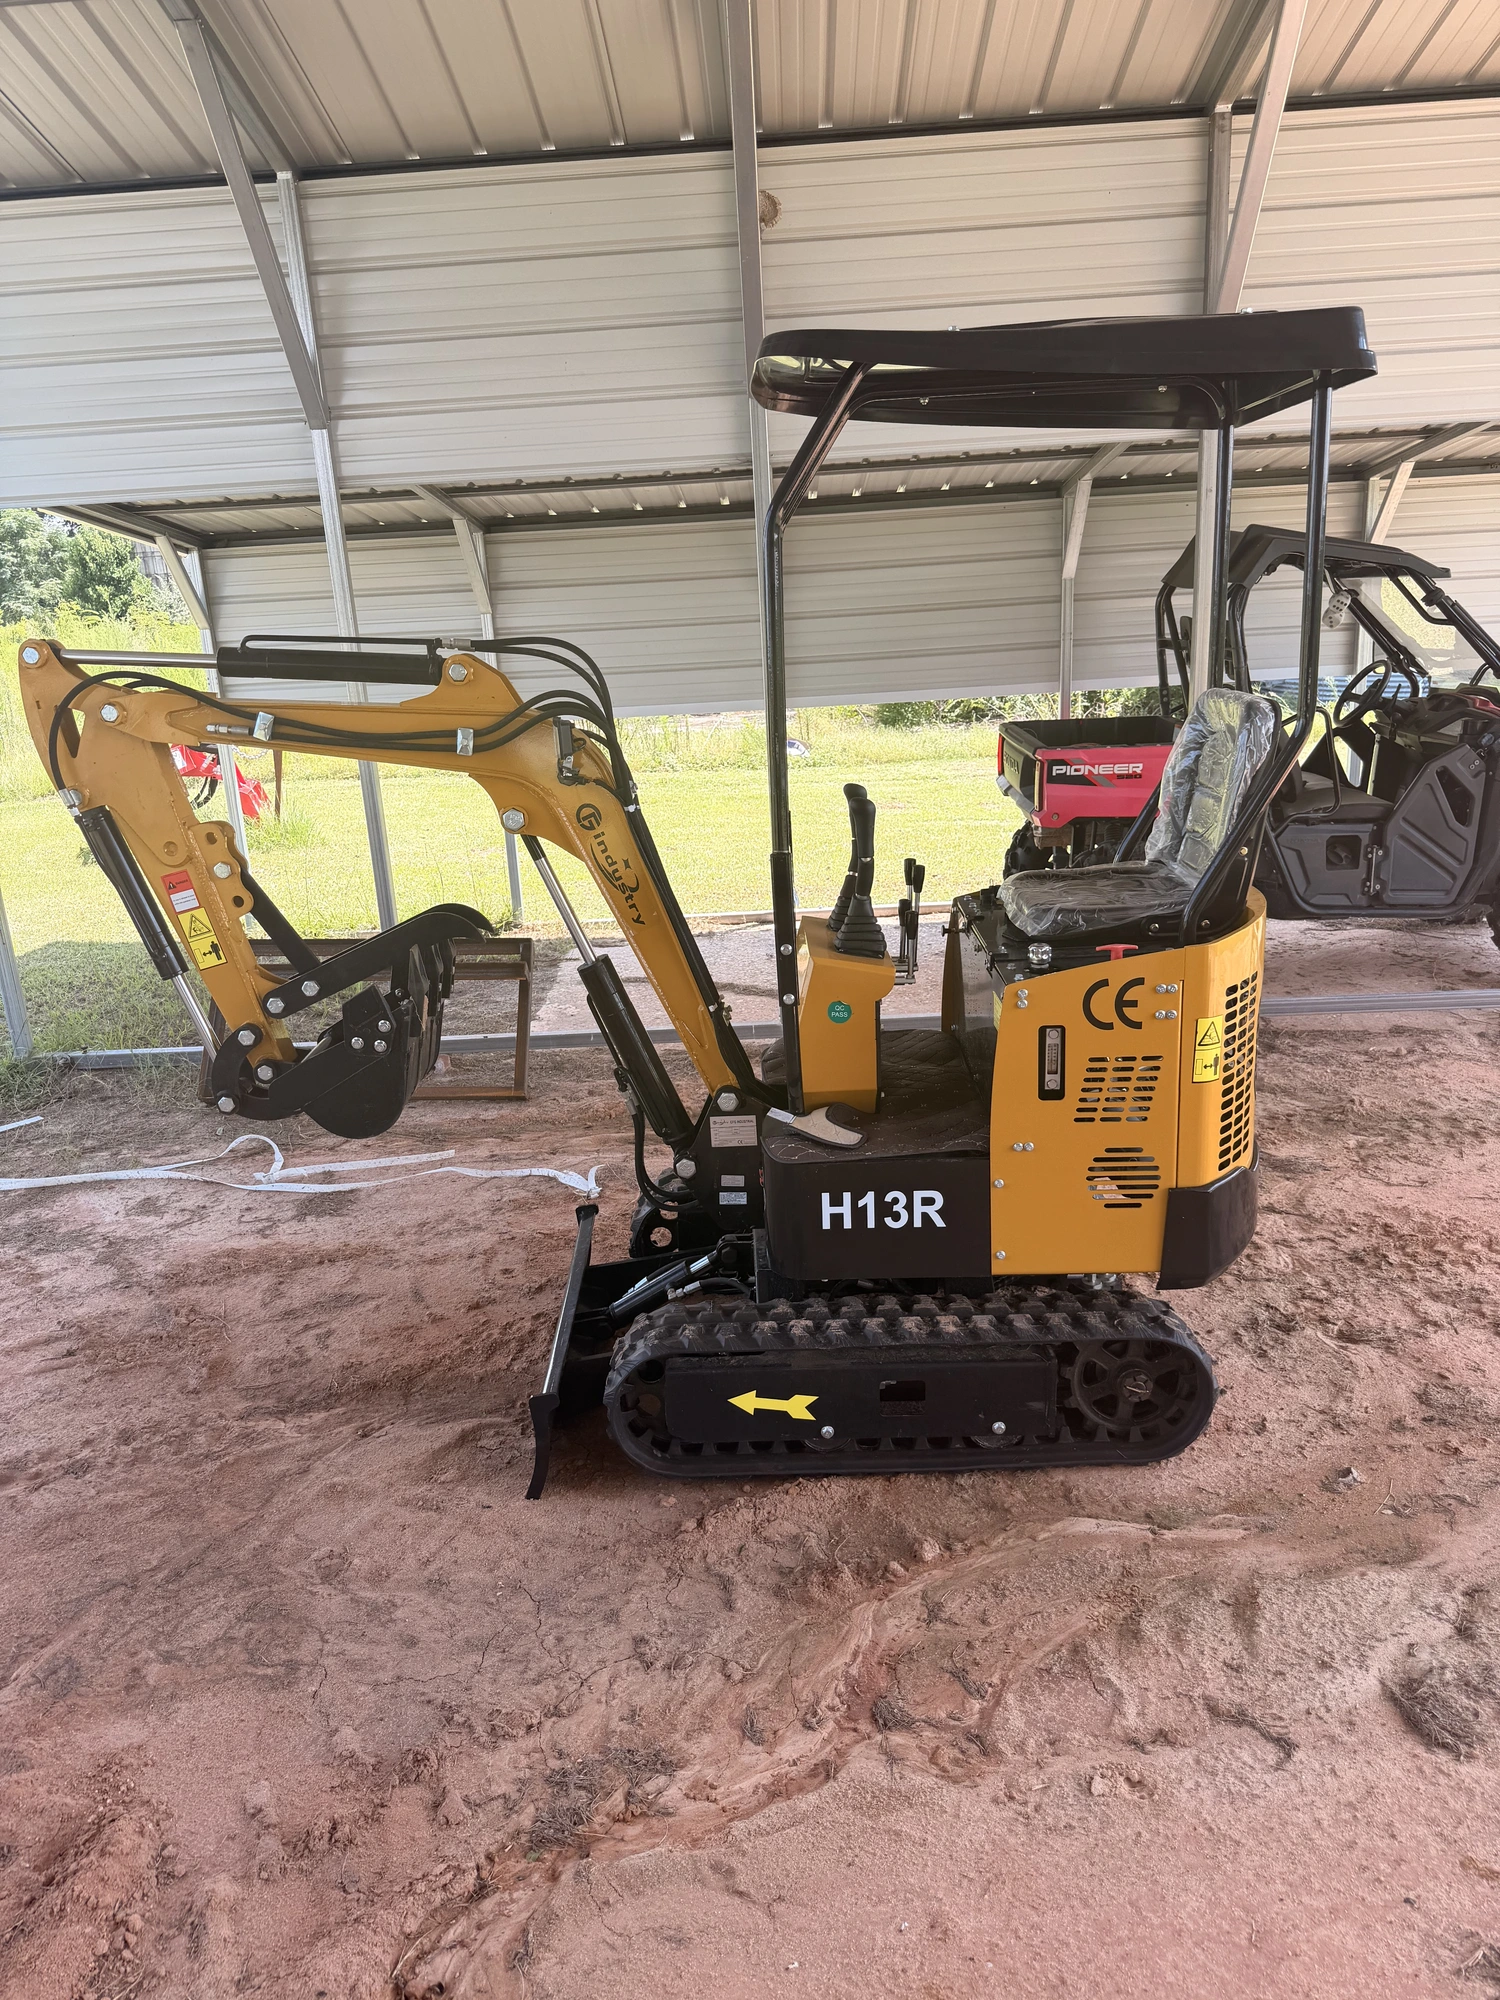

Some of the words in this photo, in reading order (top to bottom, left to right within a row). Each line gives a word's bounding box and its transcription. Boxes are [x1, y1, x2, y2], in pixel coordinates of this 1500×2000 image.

[1052, 763, 1144, 776] PIONEER
[1082, 977, 1146, 1031] CE
[821, 1189, 947, 1230] H13R
